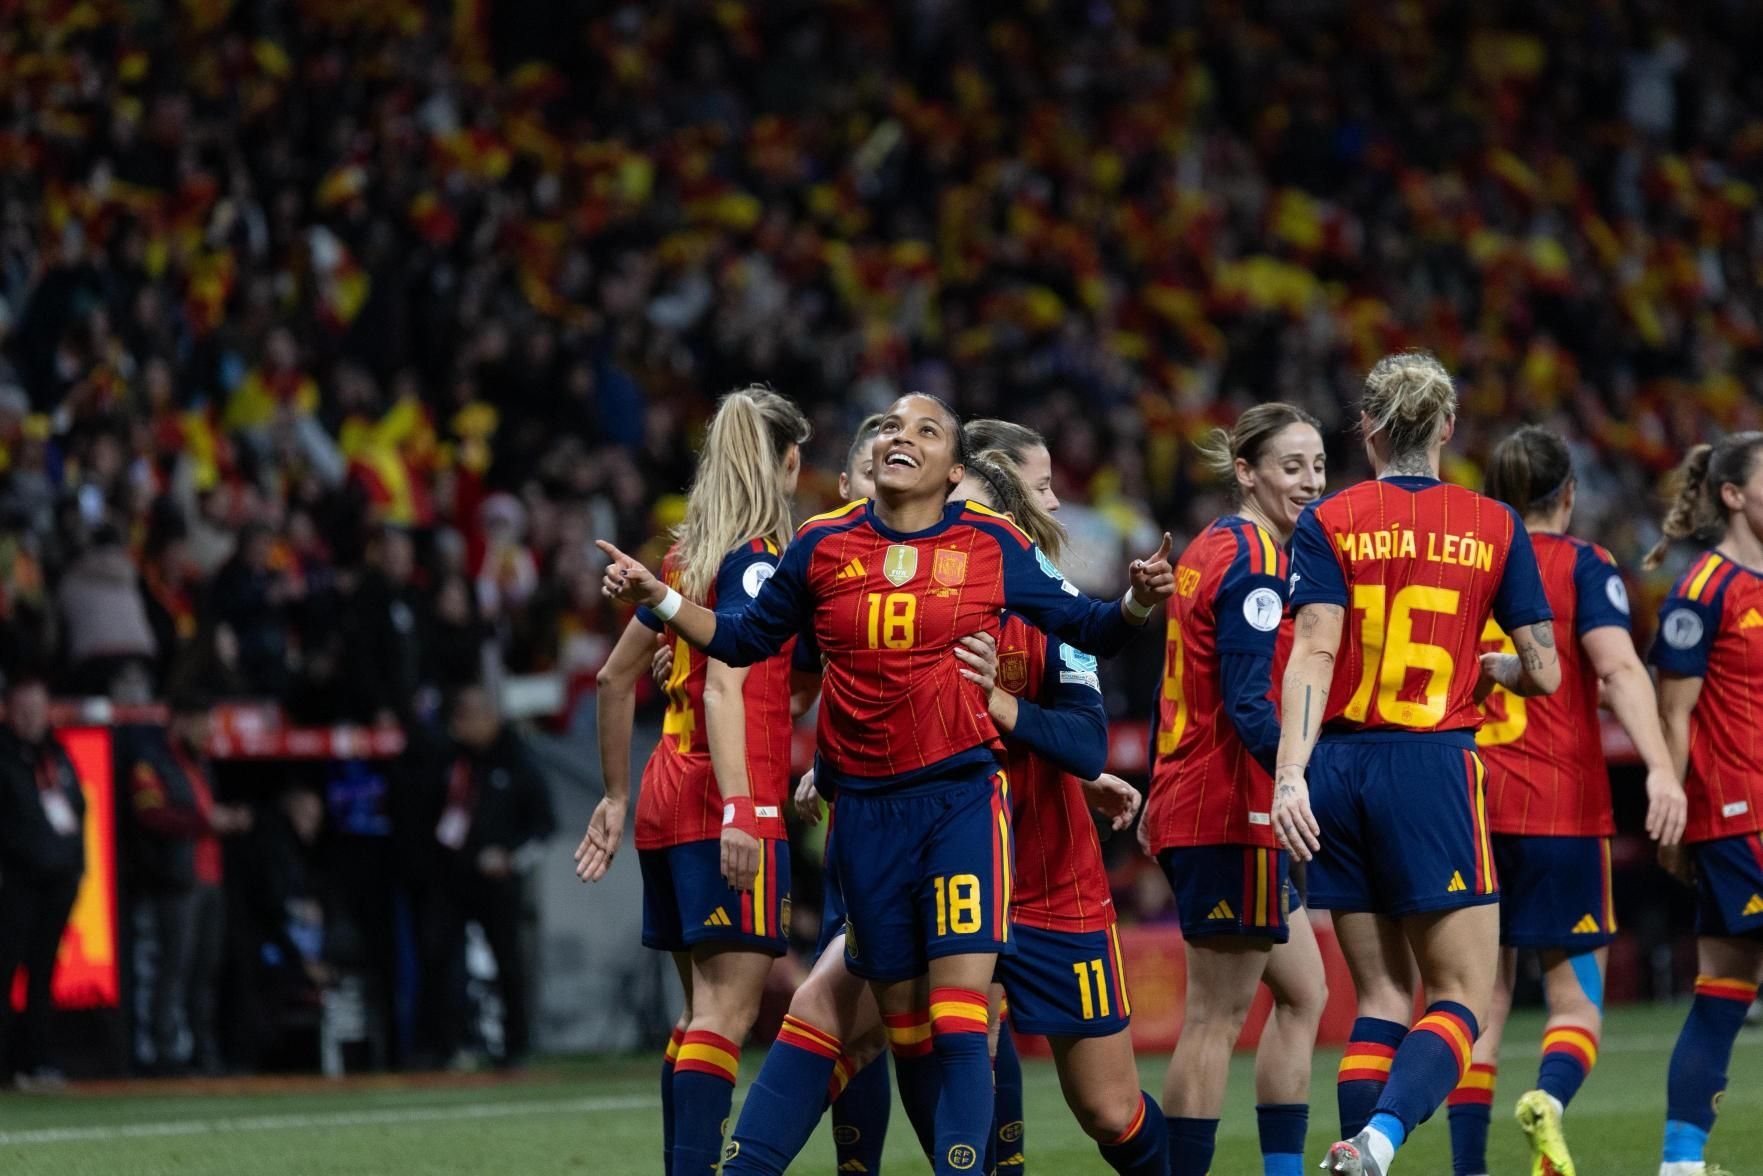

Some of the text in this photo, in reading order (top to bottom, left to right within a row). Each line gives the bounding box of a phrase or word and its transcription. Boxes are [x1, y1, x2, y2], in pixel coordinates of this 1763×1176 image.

[1335, 523, 1495, 572] MARÍA LEÓN
[867, 592, 917, 650] 18
[1157, 618, 1188, 755] 9
[1344, 584, 1460, 728] 16
[934, 874, 982, 936] 18
[1073, 958, 1110, 1020] 11
